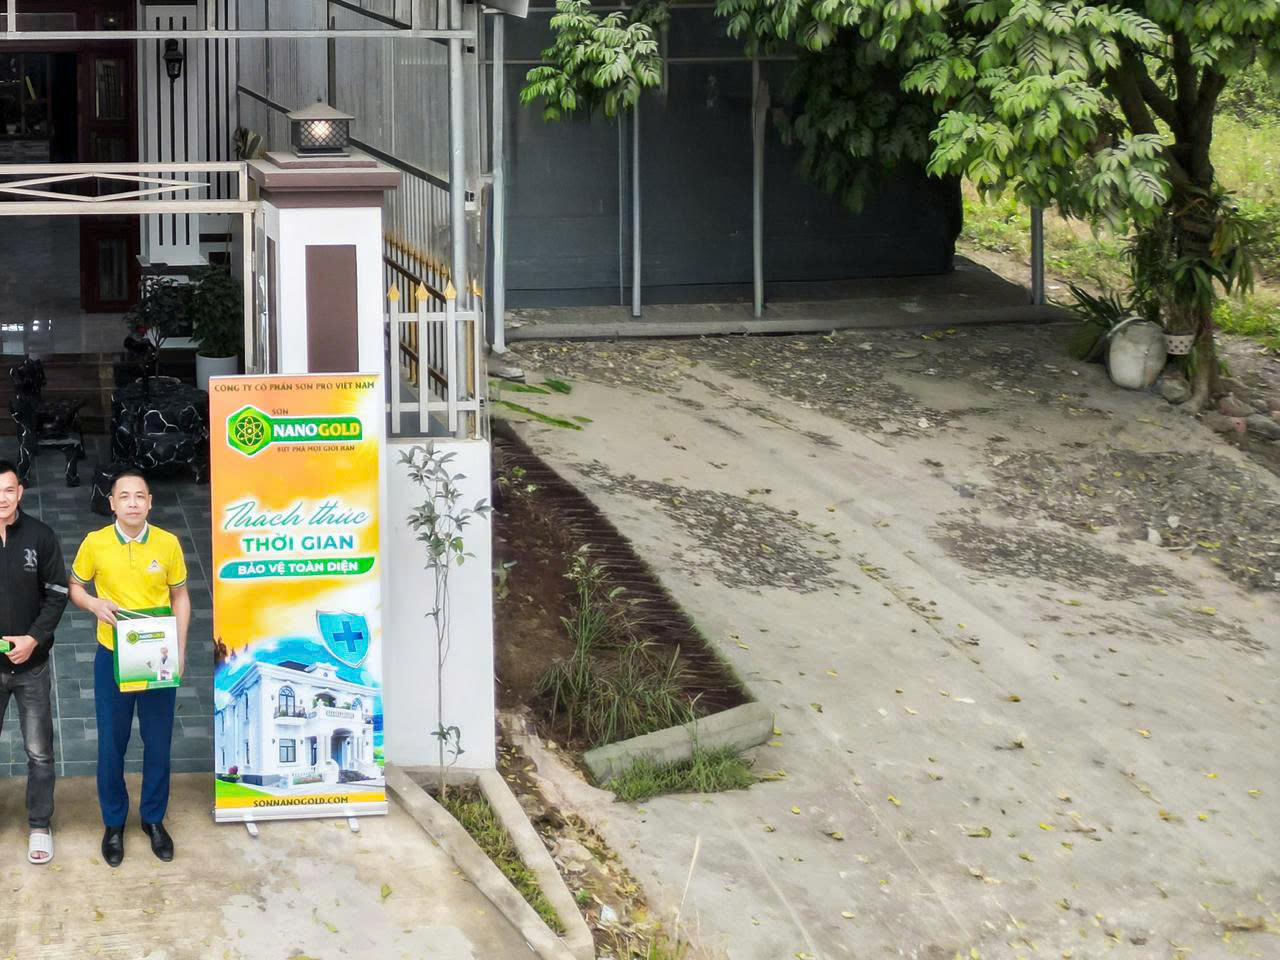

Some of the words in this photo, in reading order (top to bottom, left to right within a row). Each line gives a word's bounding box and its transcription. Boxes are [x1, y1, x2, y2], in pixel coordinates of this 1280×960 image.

[316, 382, 332, 390] PRO
[355, 382, 374, 390] NAM
[273, 422, 360, 437] NANOGOLD
[242, 533, 294, 552] THỜI
[301, 535, 354, 550] GIAN
[238, 560, 266, 575] BẢO
[268, 559, 286, 575] VỆ
[288, 558, 324, 573] TOÀN
[328, 560, 358, 574] DIỆN
[253, 796, 348, 808] SONNANOGOLD.COM
